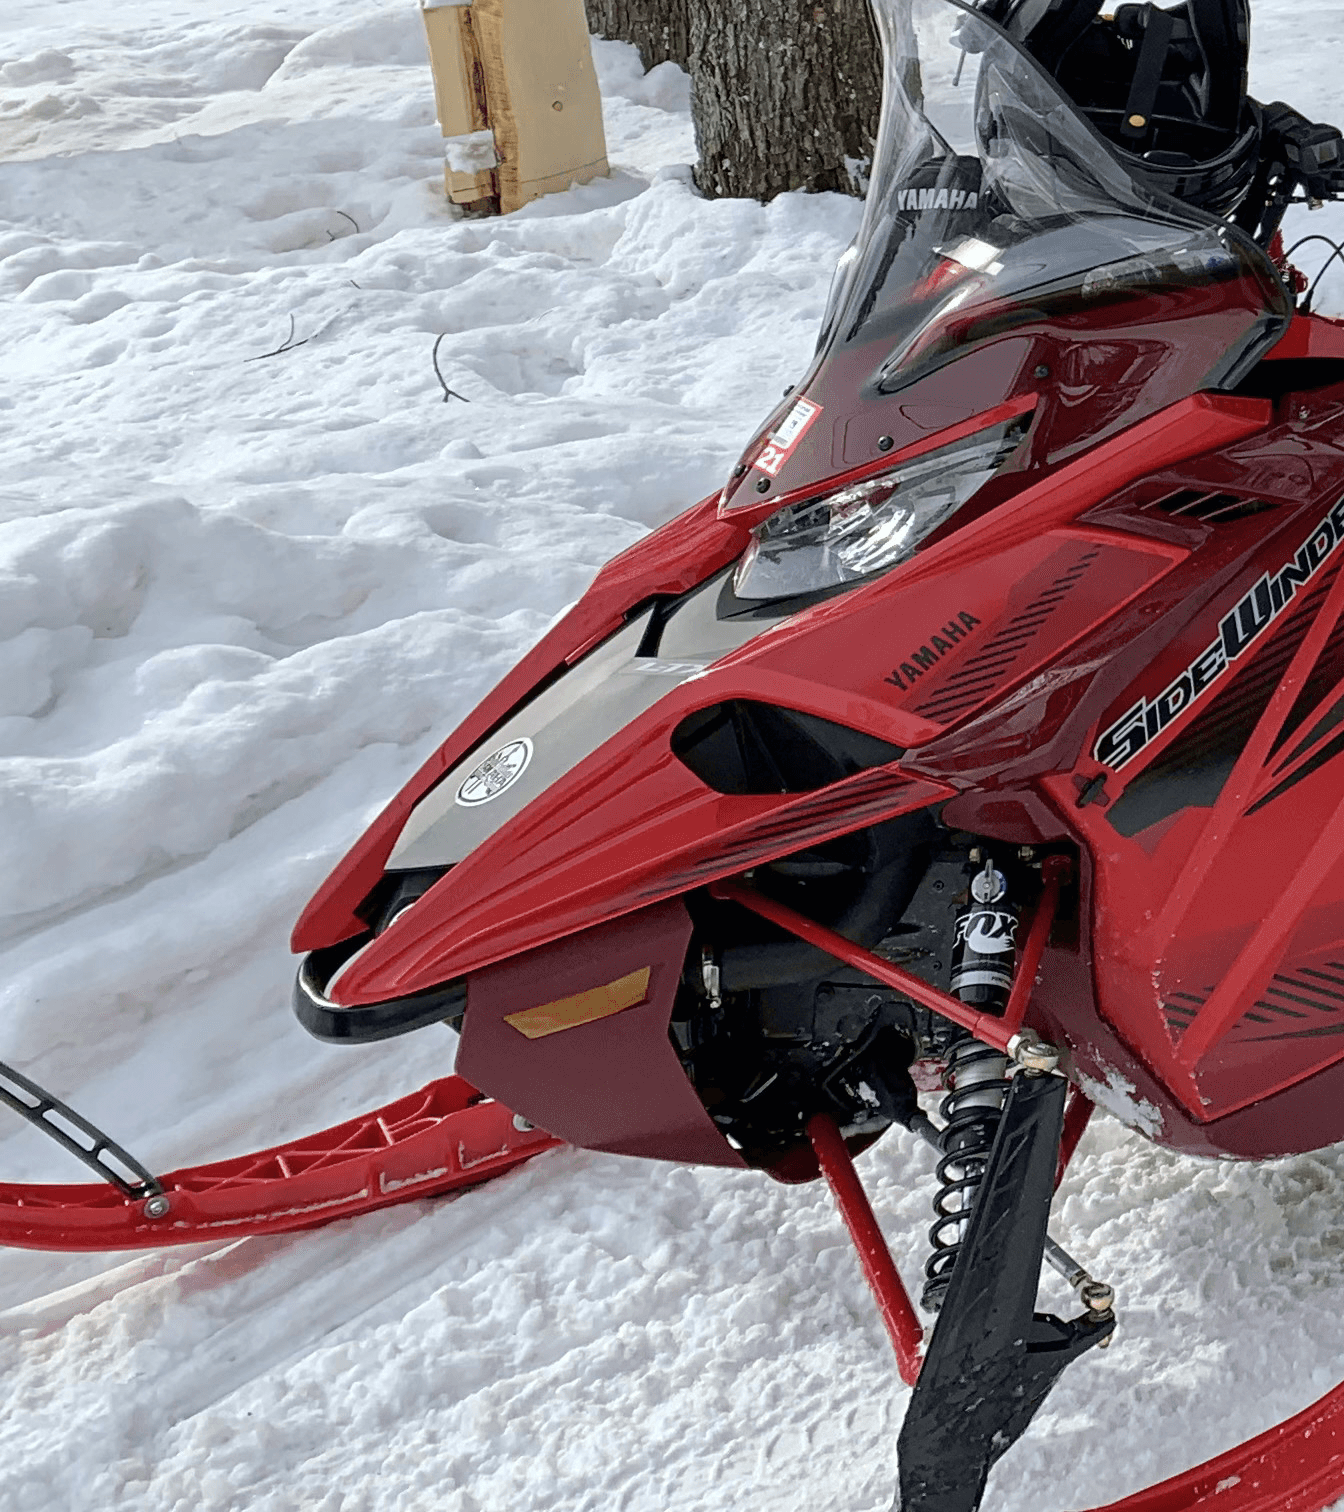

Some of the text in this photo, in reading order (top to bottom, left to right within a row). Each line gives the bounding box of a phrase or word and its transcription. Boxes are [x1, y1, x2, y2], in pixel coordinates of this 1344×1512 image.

[897, 188, 978, 211] YAMAHA
[754, 445, 786, 476] 21
[883, 610, 982, 693] YAMAHA
[952, 910, 1019, 952] FOX
